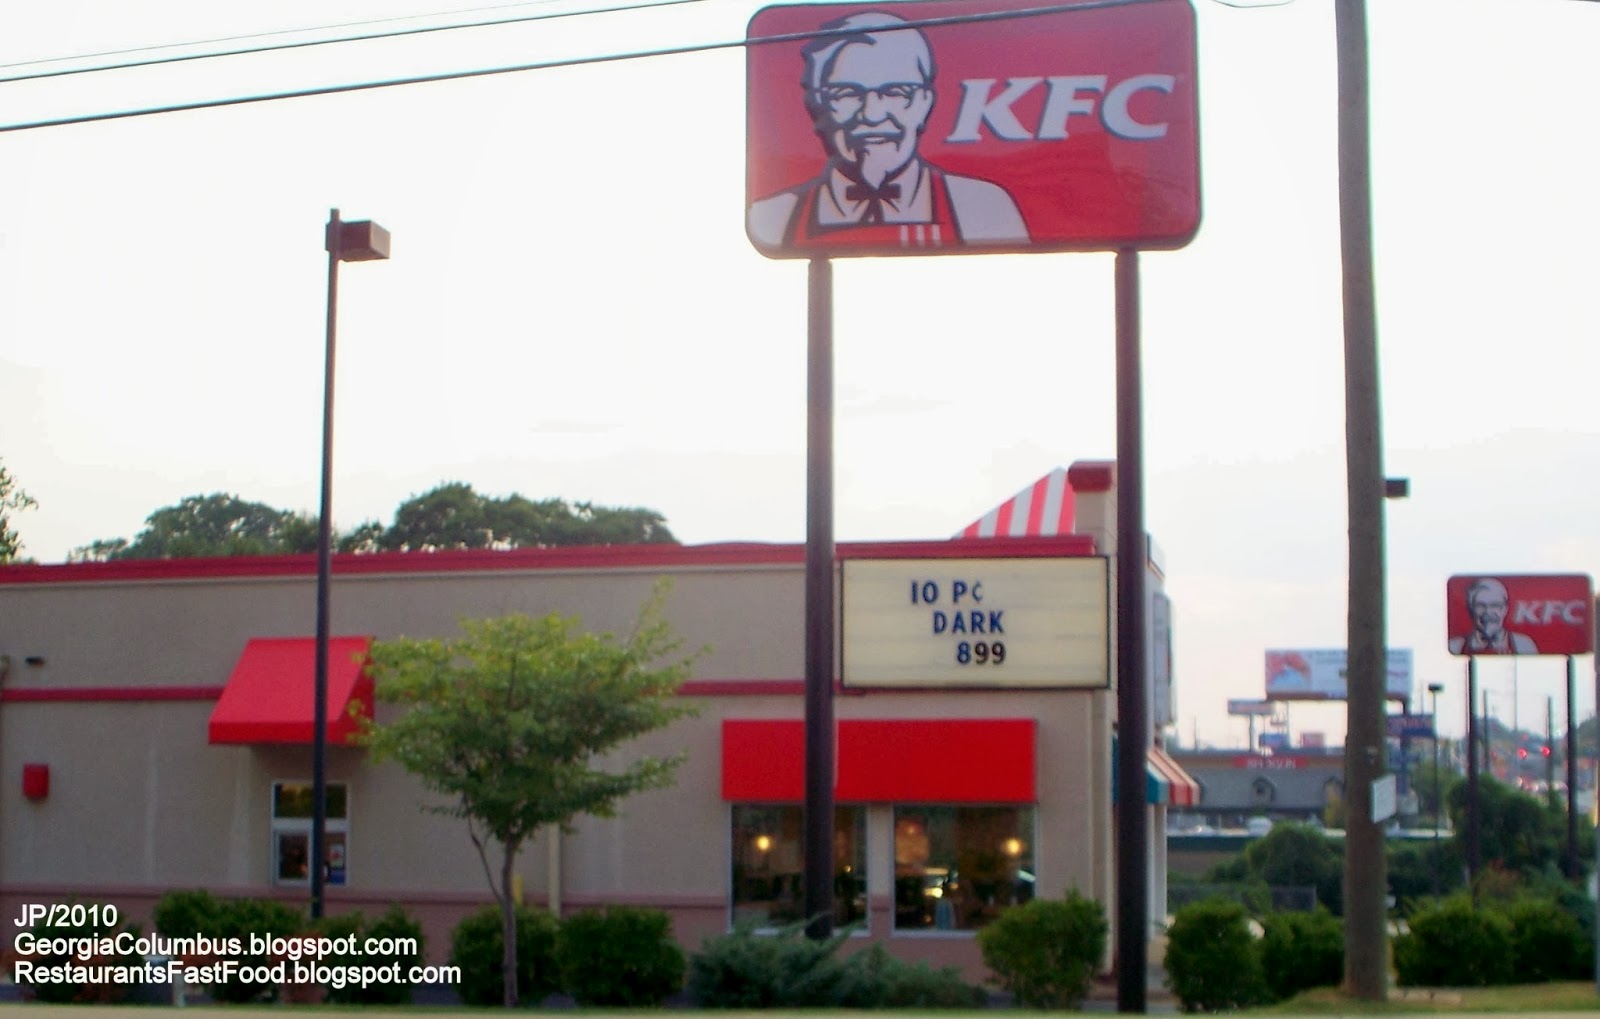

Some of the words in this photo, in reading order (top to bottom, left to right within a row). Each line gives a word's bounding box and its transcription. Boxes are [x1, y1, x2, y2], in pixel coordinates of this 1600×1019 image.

[946, 74, 1176, 143] KFC
[911, 580, 938, 604] 10
[933, 610, 1006, 634] DARK
[1514, 601, 1585, 624] KFC
[956, 641, 1007, 665] 899
